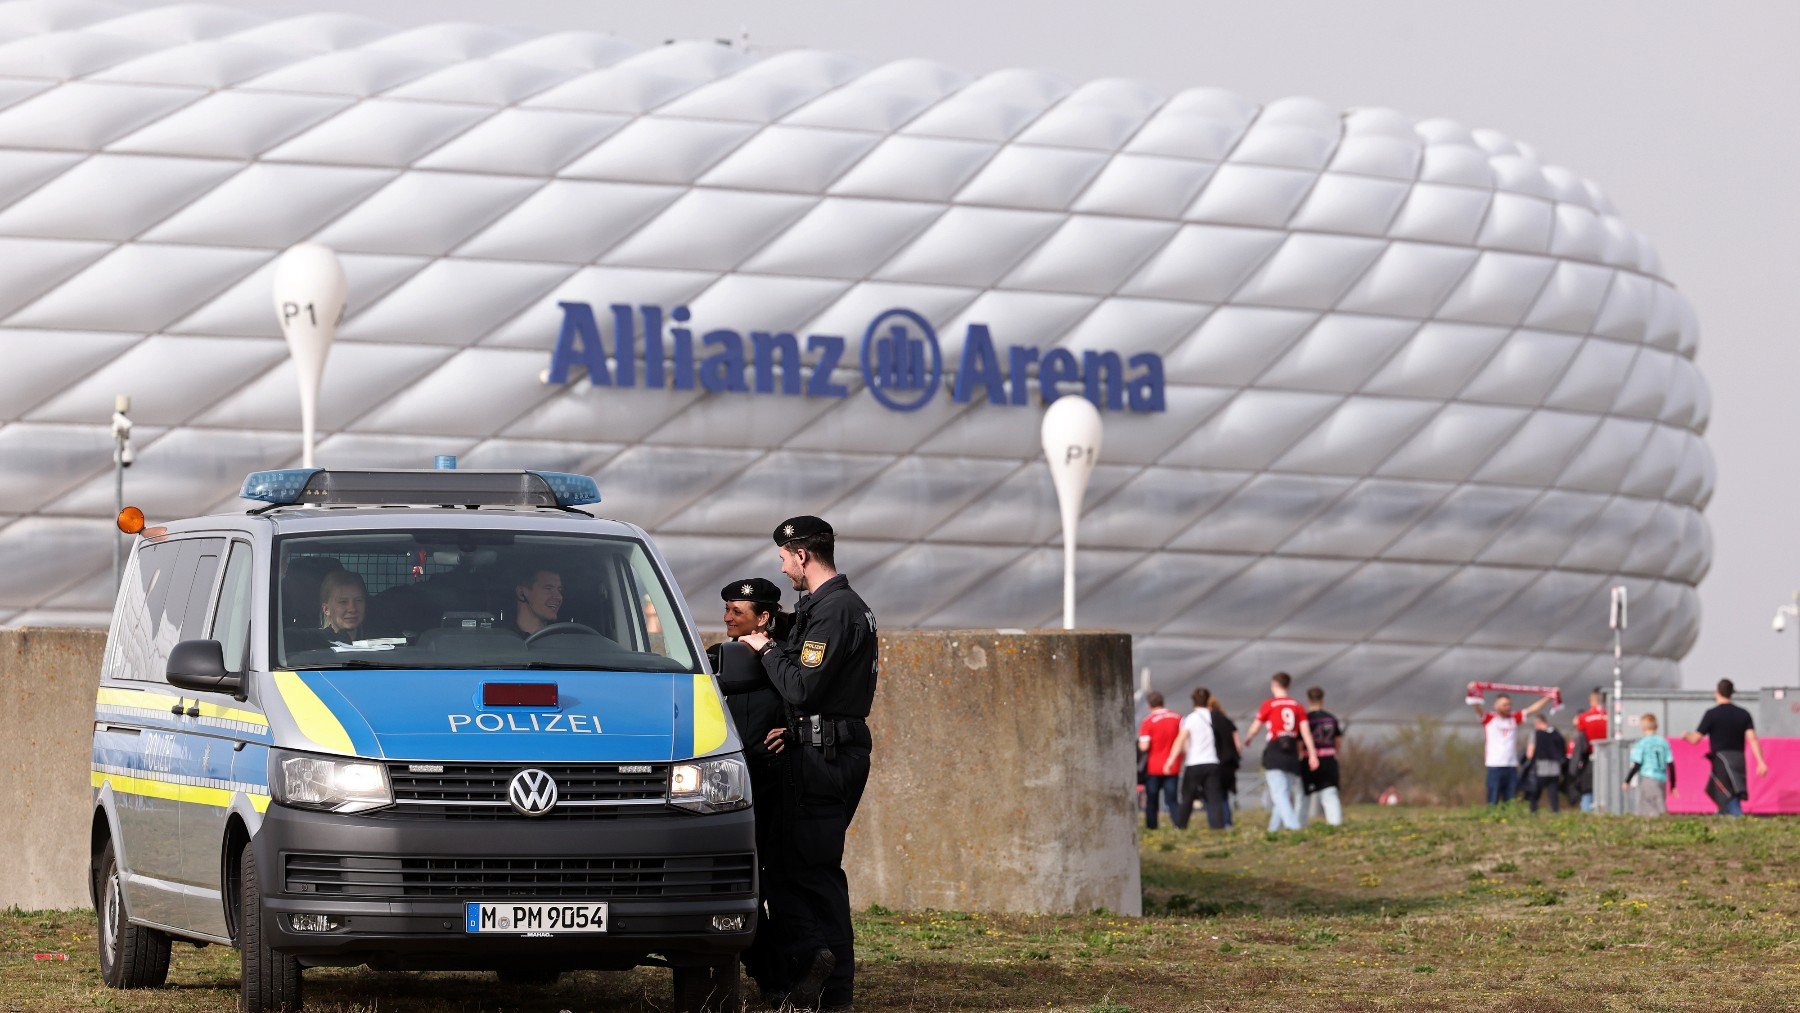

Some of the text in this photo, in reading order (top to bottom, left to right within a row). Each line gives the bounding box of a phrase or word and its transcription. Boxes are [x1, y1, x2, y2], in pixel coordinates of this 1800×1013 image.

[283, 302, 317, 327] P1
[549, 302, 1167, 412] Allianz Arena
[448, 713, 603, 734] POLIZEI
[1281, 707, 1296, 731] 9
[510, 769, 558, 814] VW
[481, 906, 603, 929] M PM 9054
